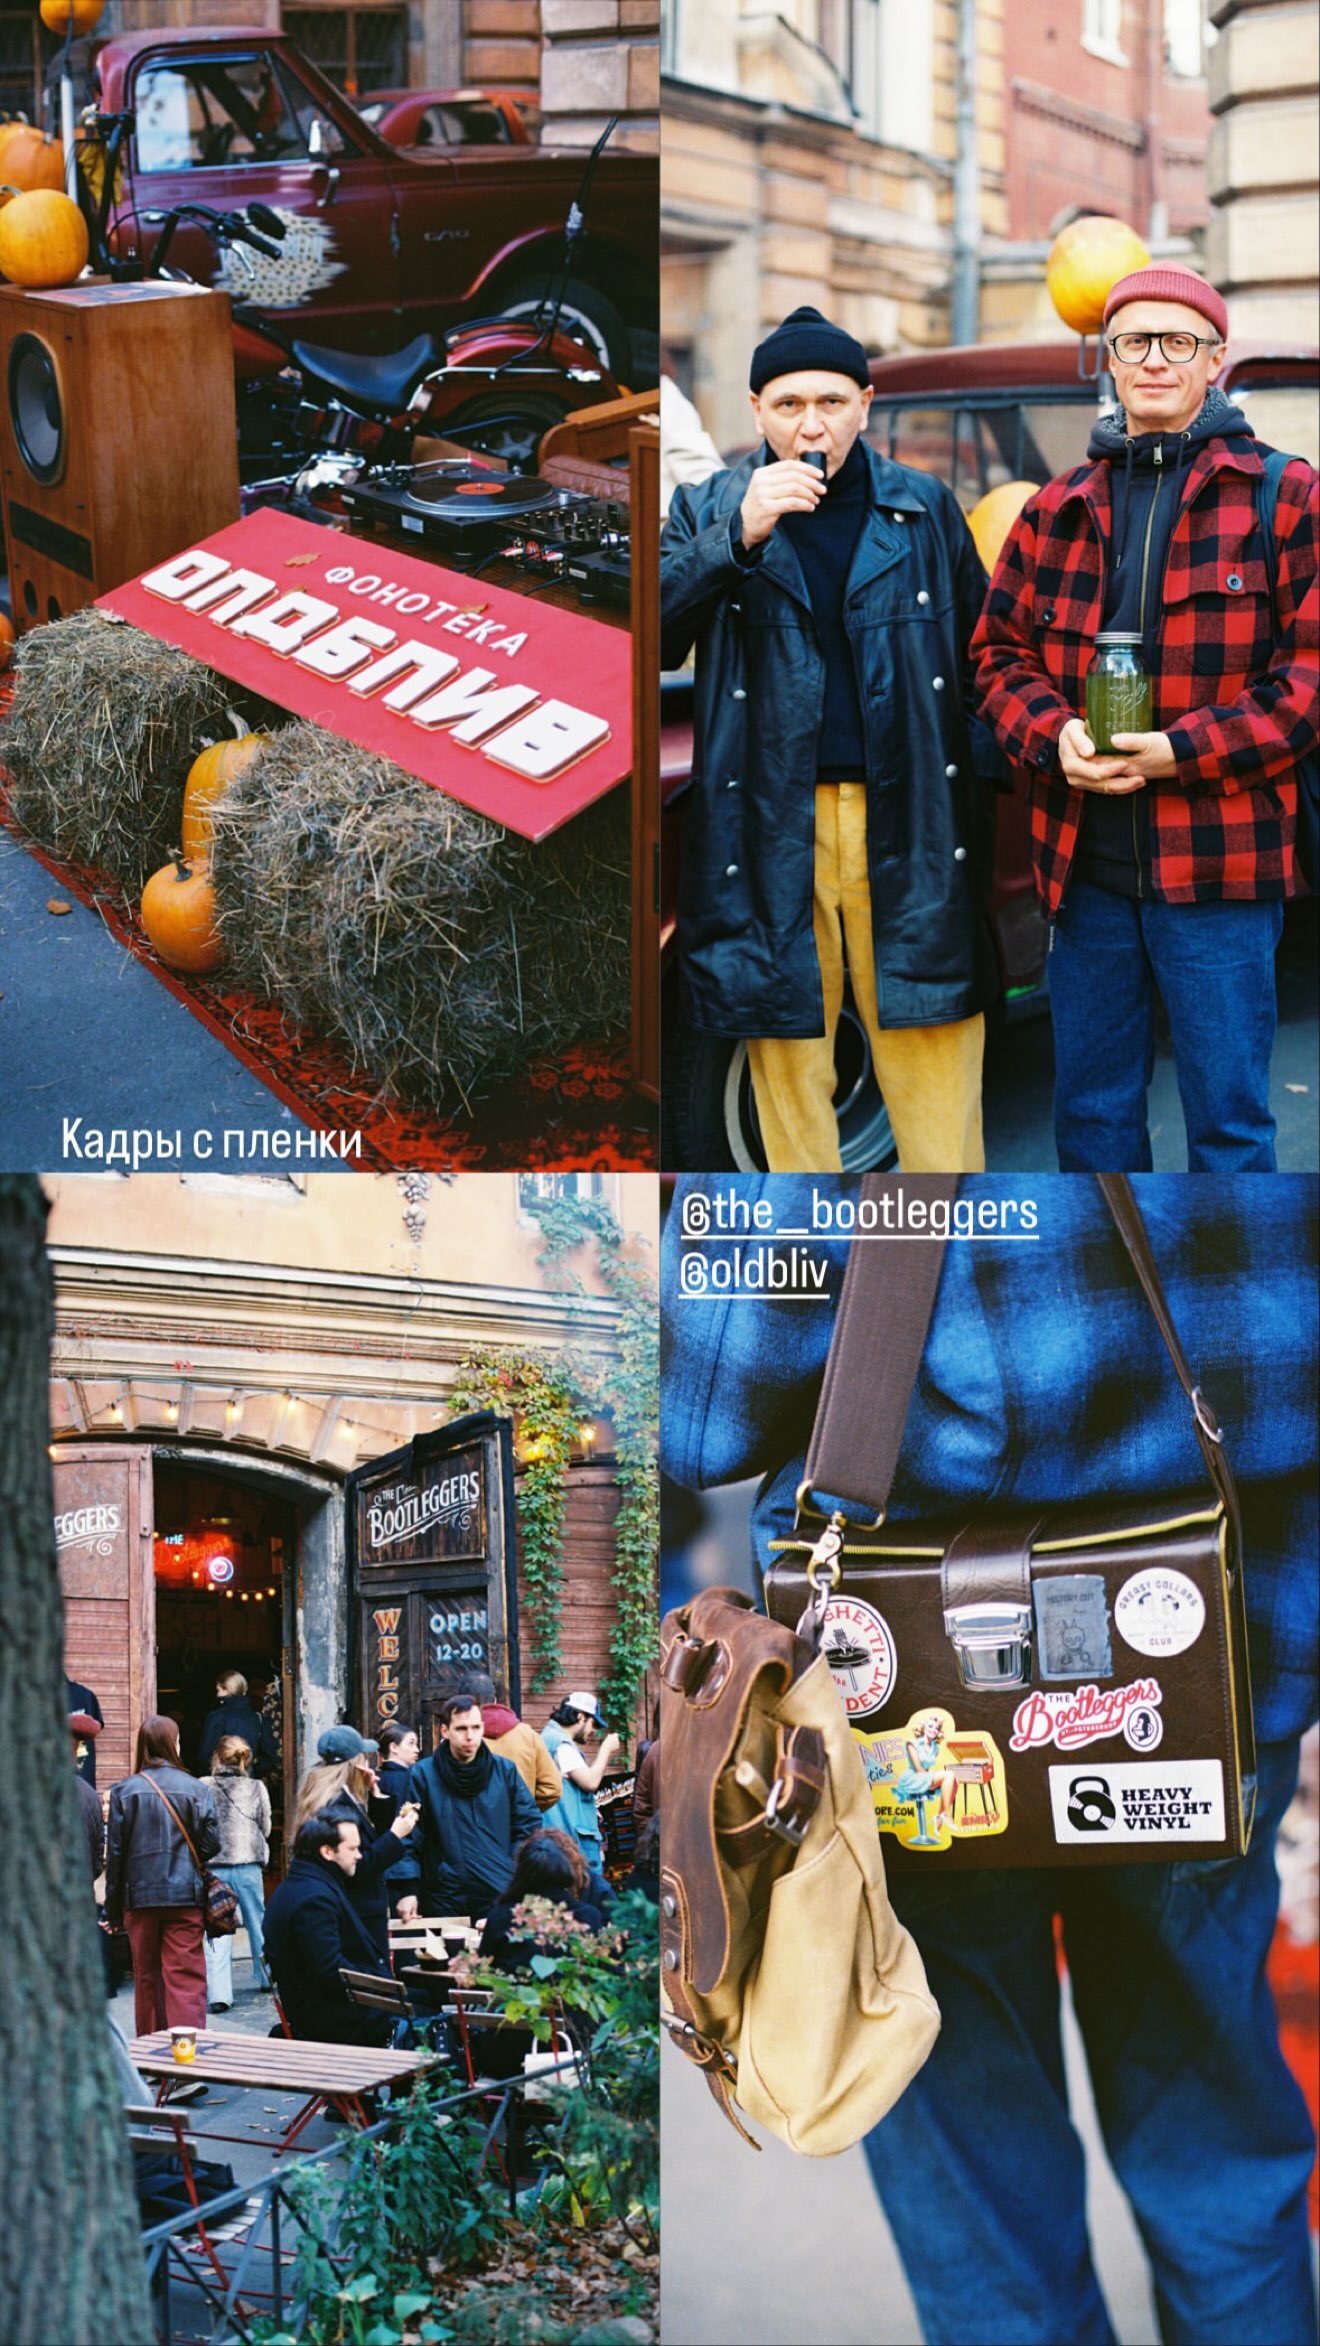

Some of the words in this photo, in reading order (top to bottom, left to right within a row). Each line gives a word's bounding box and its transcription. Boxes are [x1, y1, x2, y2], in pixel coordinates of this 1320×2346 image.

[324, 565, 529, 658] ФОНОТЕКА
[382, 1489, 395, 1500] THE
[366, 1471, 480, 1543] BOOTLEGGERS
[54, 1505, 119, 1539] EGGERS
[430, 1610, 488, 1634] OPEN
[436, 1642, 484, 1661] 12-20
[842, 1667, 889, 1711] DENT
[1048, 1694, 1071, 1703] THE
[1012, 1680, 1158, 1748] Bootleggers
[1121, 1787, 1193, 1802] HEAVY
[1122, 1801, 1212, 1817] WEIGHT
[1123, 1816, 1191, 1830] VINYL
